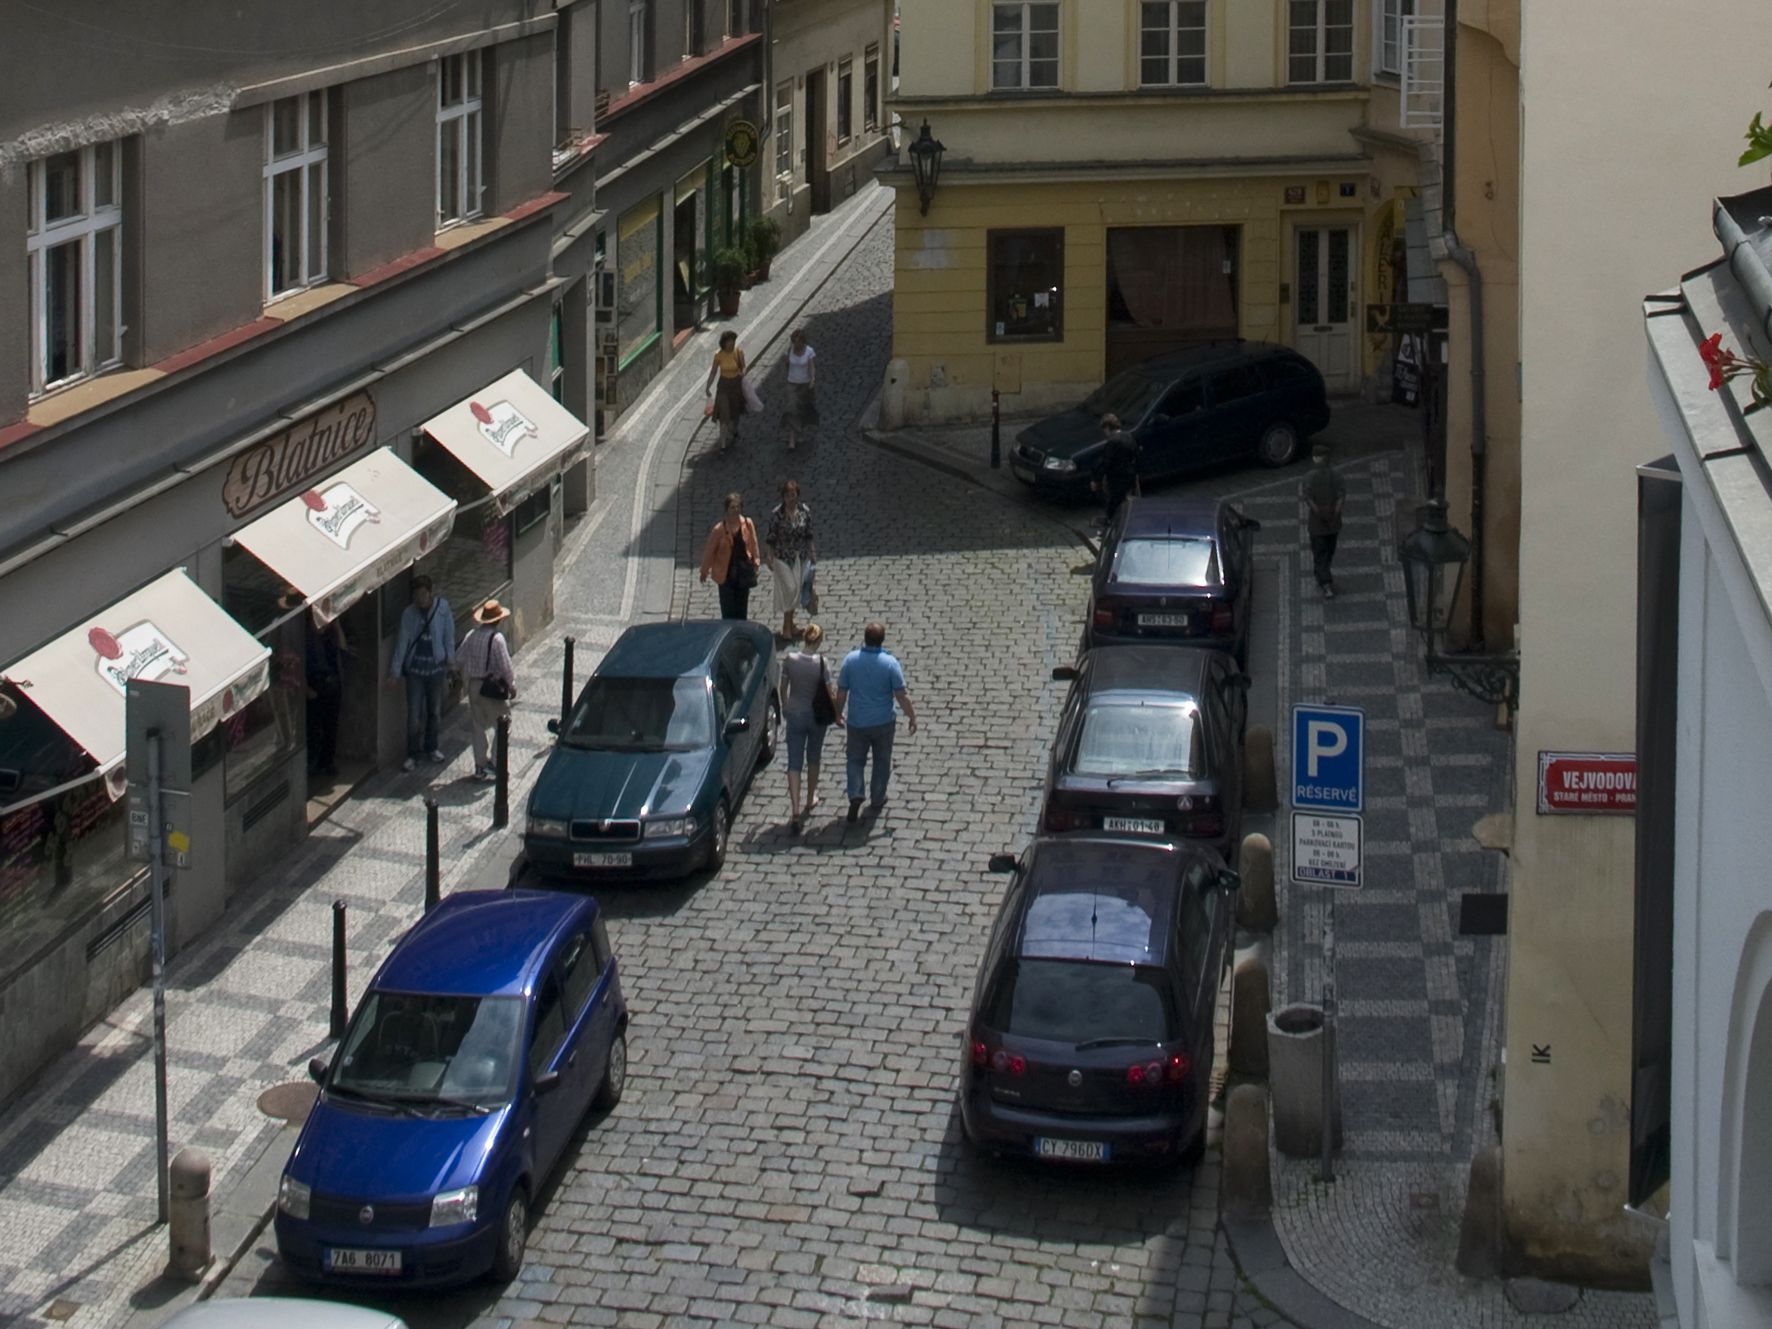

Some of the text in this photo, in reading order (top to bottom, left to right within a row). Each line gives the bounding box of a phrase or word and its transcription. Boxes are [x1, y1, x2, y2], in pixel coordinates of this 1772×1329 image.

[236, 403, 367, 510] Blatnice
[1308, 720, 1347, 777] P
[1297, 784, 1358, 802] RÉSERVÉ
[1553, 791, 1579, 802] STARÉ
[1299, 867, 1336, 880] OBLAST
[333, 1251, 395, 1266] 7A6 8071
